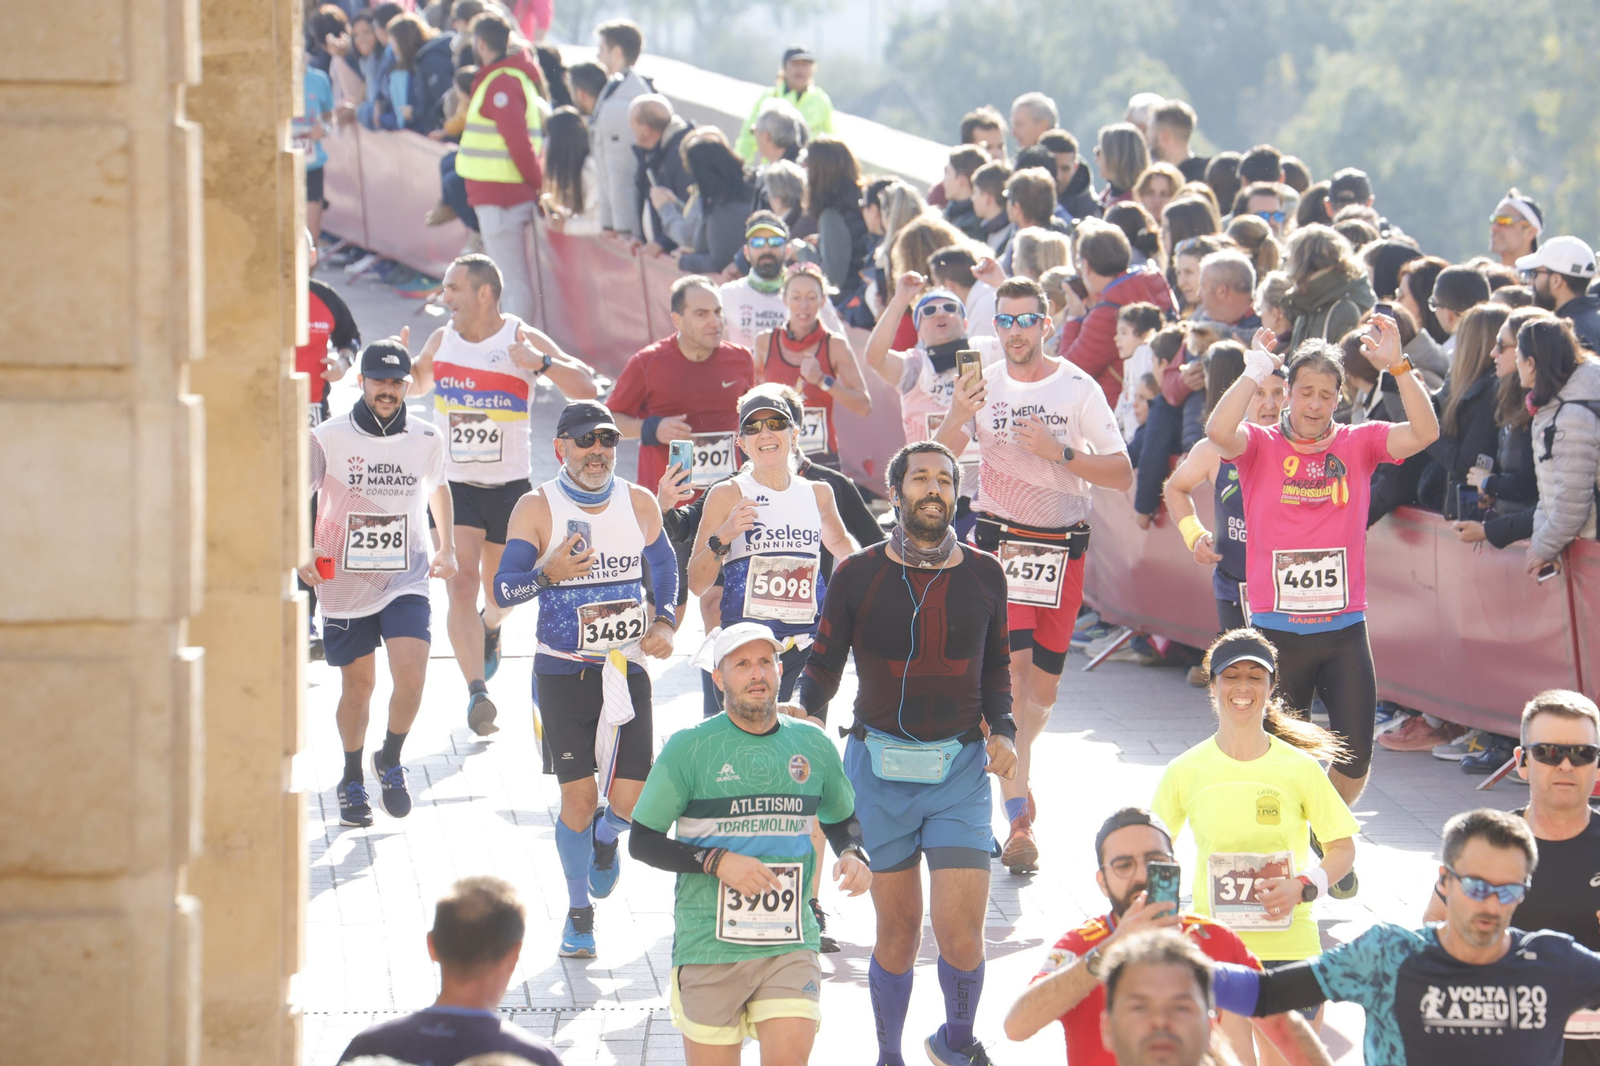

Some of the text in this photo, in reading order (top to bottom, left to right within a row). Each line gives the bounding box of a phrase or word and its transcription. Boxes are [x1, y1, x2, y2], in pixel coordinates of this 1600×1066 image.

[439, 376, 476, 389] Club
[462, 394, 512, 408] Bestia
[1011, 404, 1046, 418] MEDIA
[992, 418, 1008, 430] 37
[452, 428, 499, 444] 2996
[367, 463, 403, 474] MEDIA
[1282, 455, 1300, 478] 9
[348, 472, 418, 486] 37 MARATÓN
[1283, 477, 1328, 489] CARRERA
[365, 487, 404, 496] CÓRDOBA
[1282, 484, 1332, 498] UNIVERSIDAD
[350, 530, 403, 549] 2598
[745, 540, 802, 553] RUNNING
[1005, 561, 1057, 583] 4573
[1283, 569, 1338, 589] 4615
[753, 574, 811, 600] 5098
[585, 618, 642, 644] 3482
[729, 797, 803, 815] ATLETISMO
[726, 887, 795, 913] 3909
[1446, 984, 1548, 1009] VOLTA 20
[1446, 1002, 1547, 1031] A PEU 23
[1423, 1026, 1504, 1036] CULLERA
